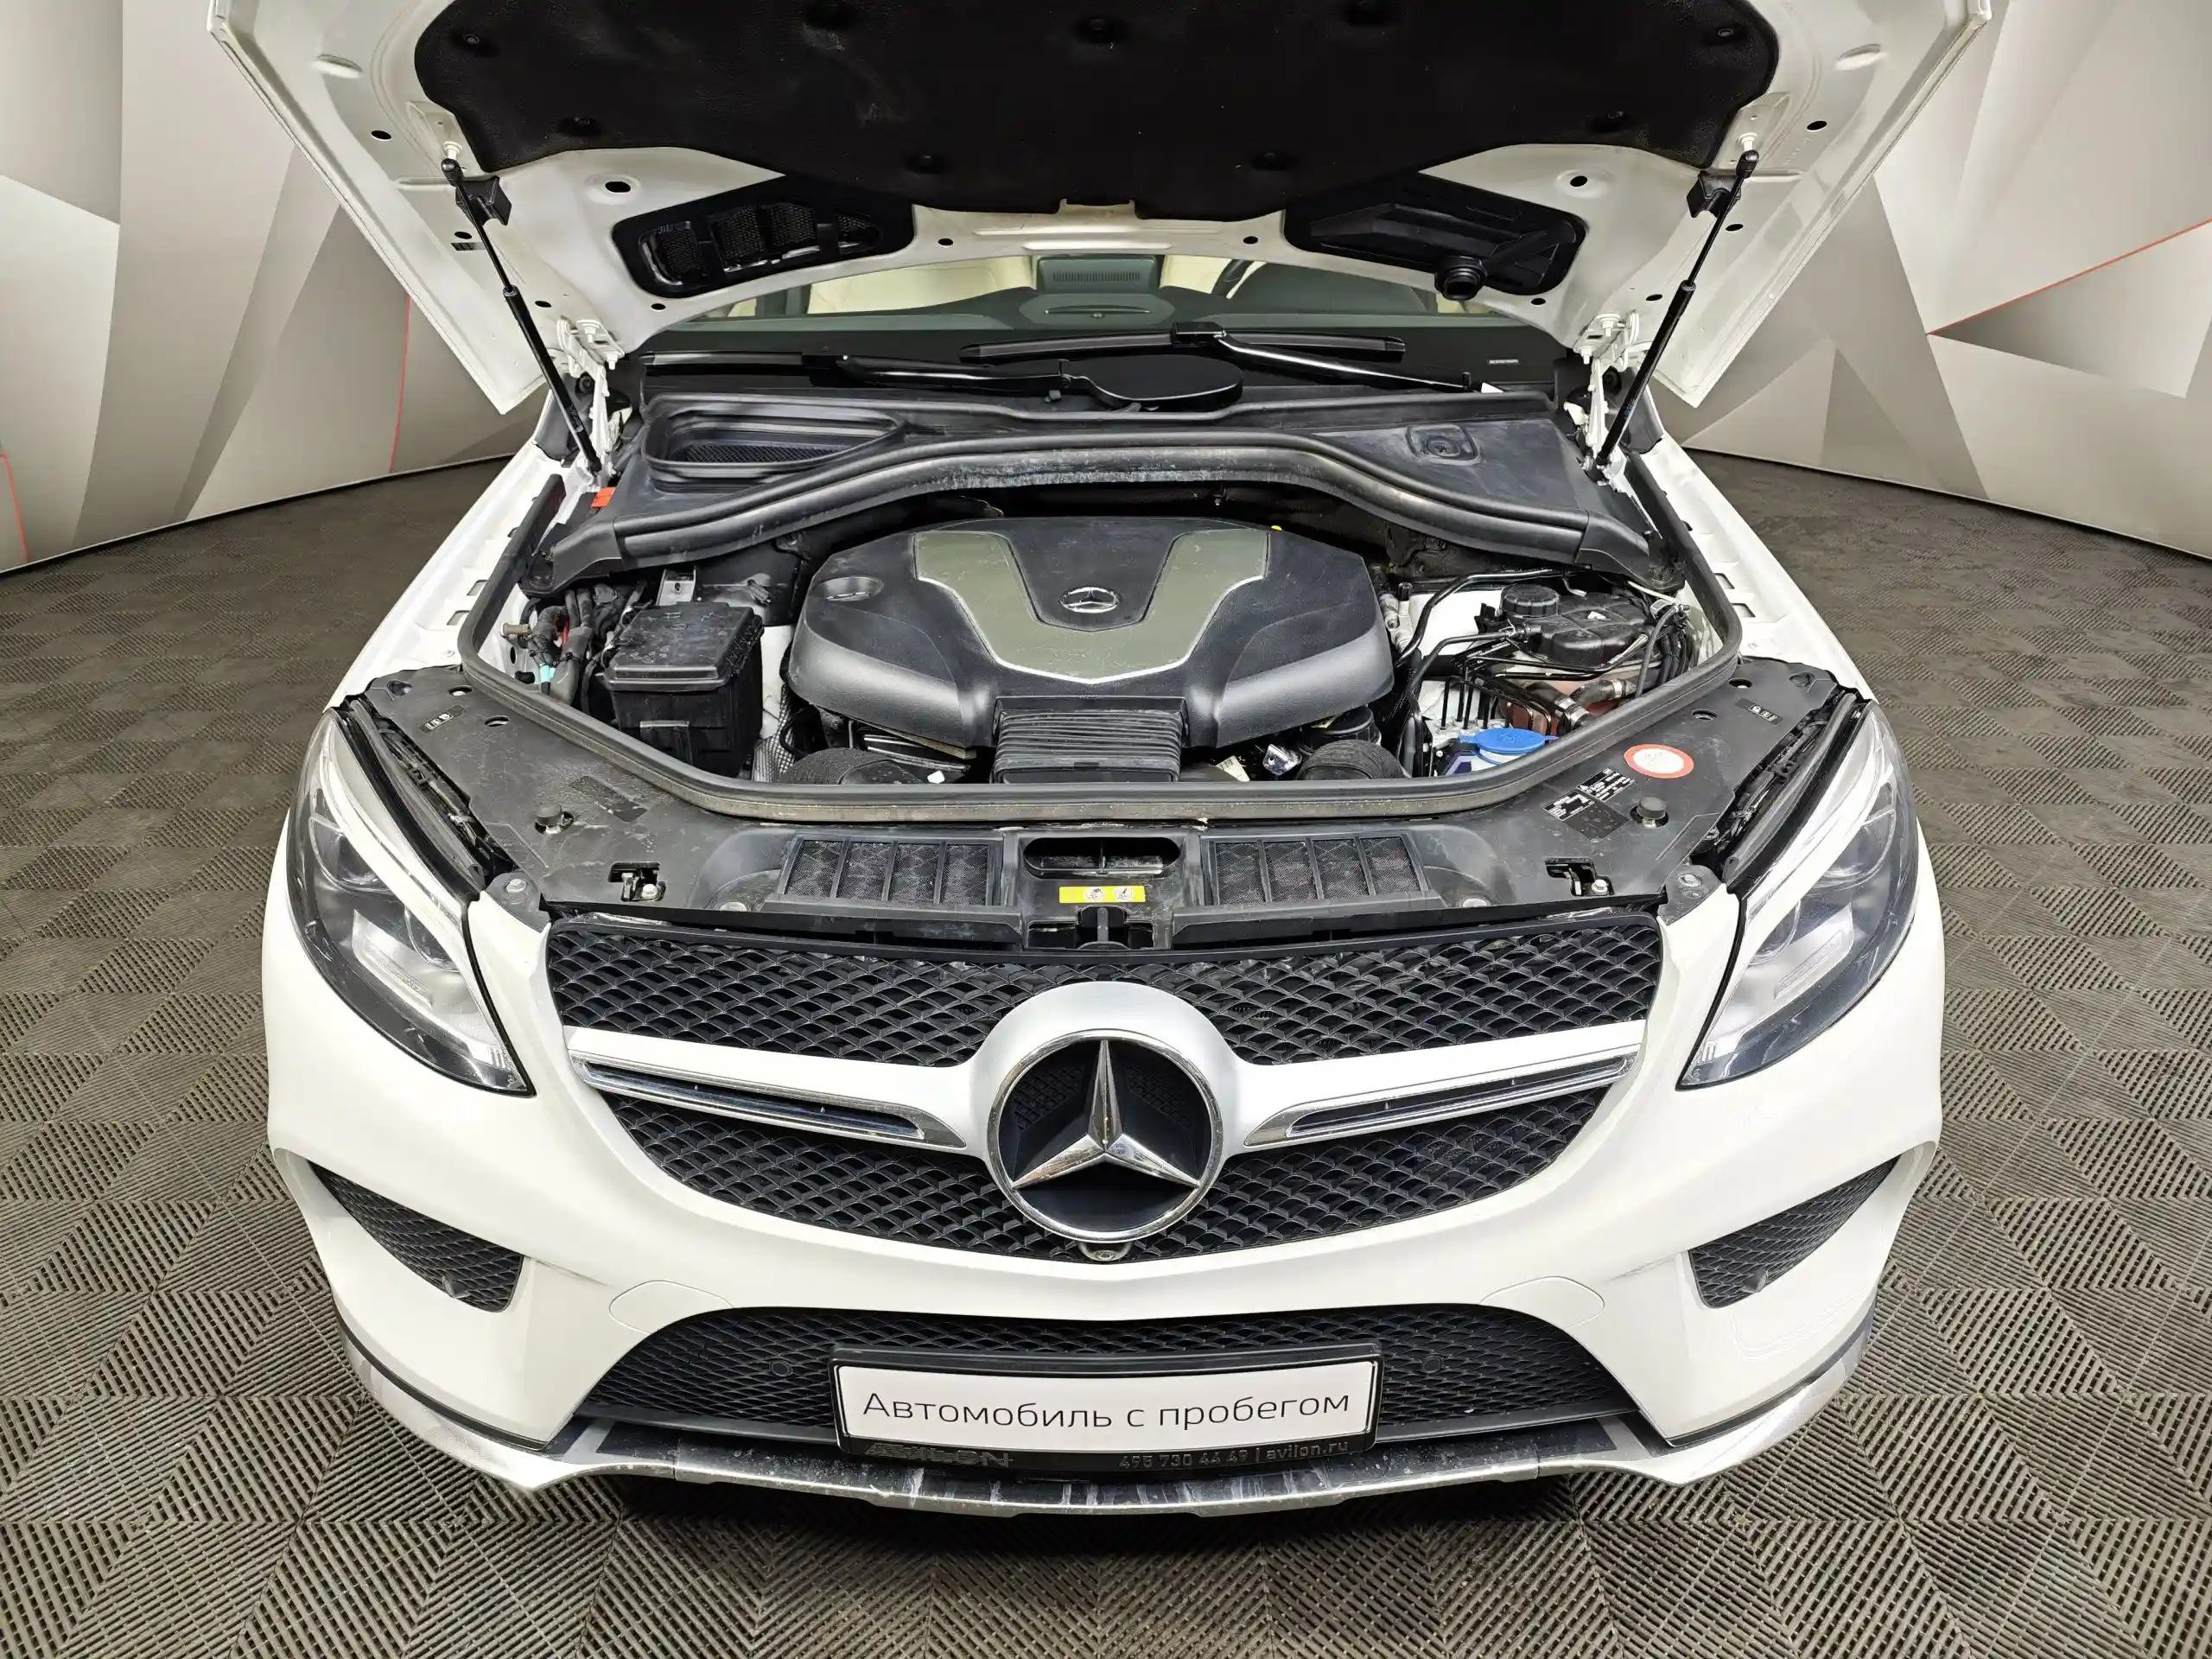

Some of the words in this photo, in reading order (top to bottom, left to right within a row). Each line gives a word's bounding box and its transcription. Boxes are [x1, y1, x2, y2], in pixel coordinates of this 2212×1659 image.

[862, 1392, 1113, 1427] Автомобиль
[1126, 1408, 1145, 1427] с
[1160, 1394, 1350, 1431] пробегом
[1118, 1455, 1154, 1469] 495
[1159, 1453, 1193, 1467] 730
[1266, 1441, 1349, 1460] avilon.ru
